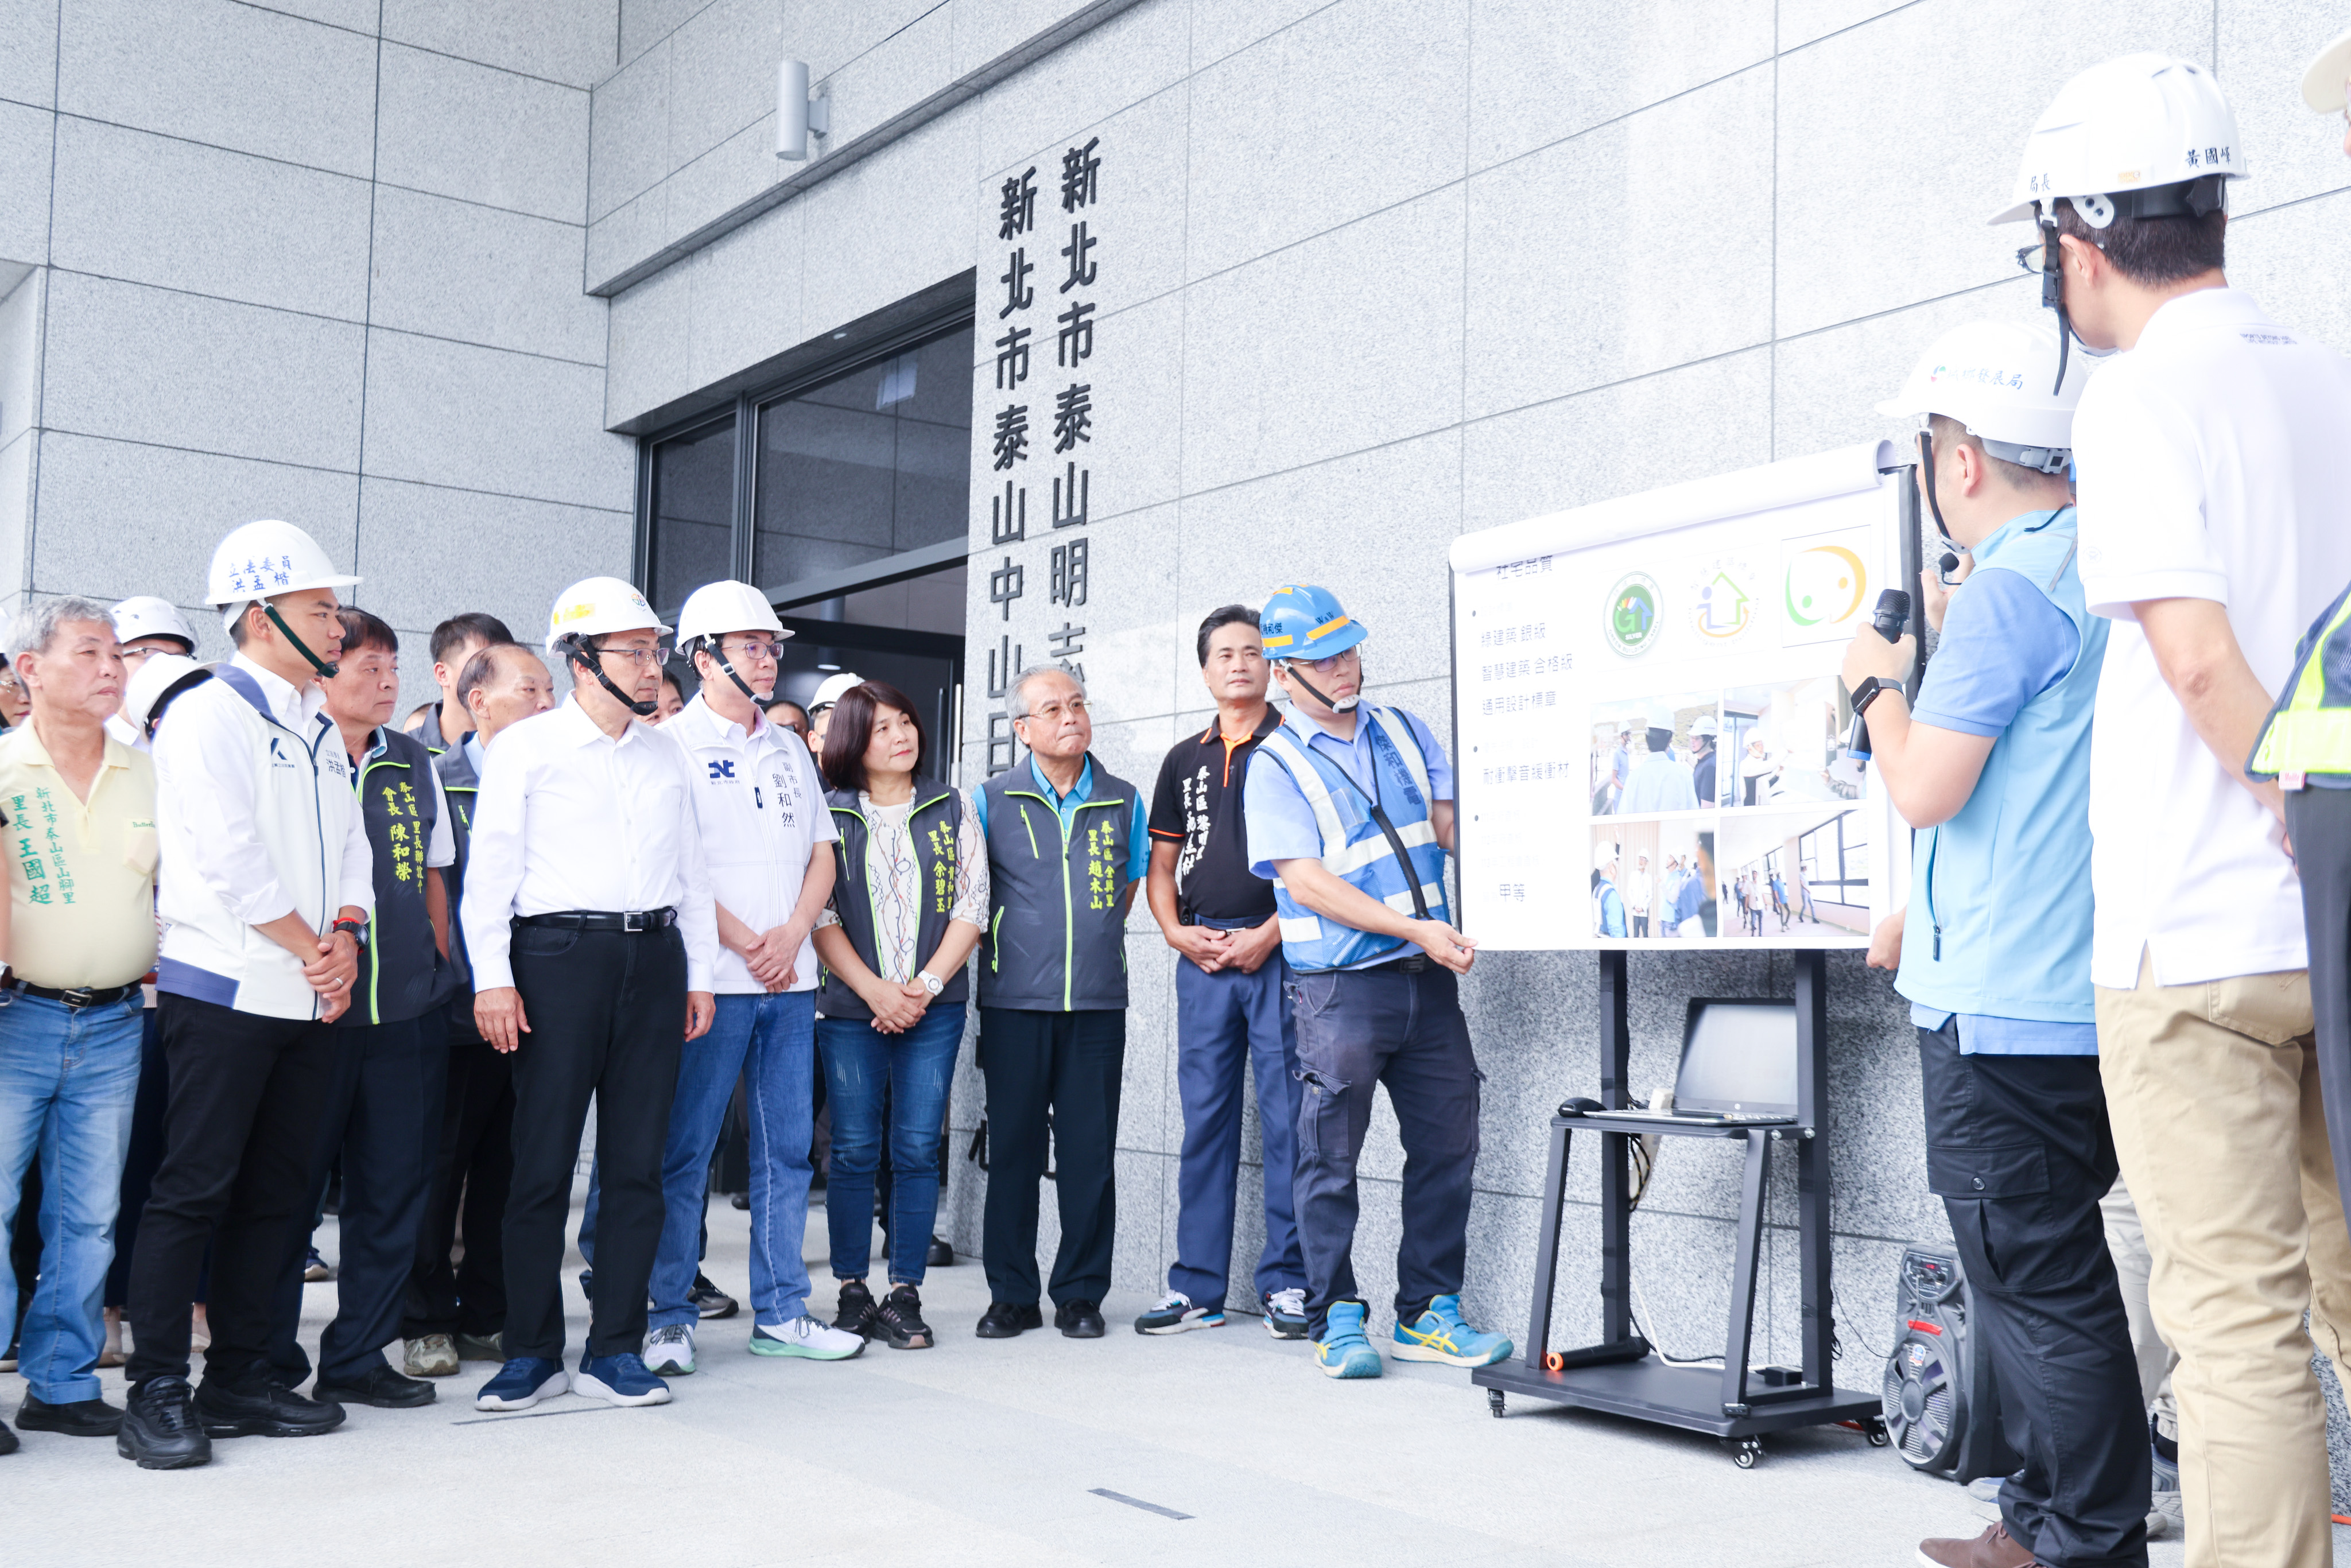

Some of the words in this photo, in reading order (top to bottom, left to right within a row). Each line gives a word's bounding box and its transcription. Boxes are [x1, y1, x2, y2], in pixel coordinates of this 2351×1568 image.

[2185, 146, 2230, 168] 黃國峰
[2030, 173, 2051, 193] 局長
[229, 556, 292, 577] 立法委員
[232, 572, 289, 593] 洪孟楷
[1481, 627, 1516, 648] 綠建築
[1520, 622, 1546, 642] 銀級
[1625, 632, 1642, 640] SILVER
[1481, 659, 1530, 682] 智慧建築
[1534, 653, 1573, 674] 合格級
[1482, 690, 1557, 716] 通用設計標章
[782, 762, 802, 799] 副市長
[1483, 760, 1569, 785] 耐衝擊音緩衝材
[11, 795, 34, 830] 里長
[382, 787, 403, 816] 會長
[772, 773, 795, 828] 劉和然
[36, 787, 76, 904] 新北市泰山區山腳里
[390, 822, 412, 882] 陳和榮
[928, 830, 945, 856] 里長
[1088, 829, 1101, 856] 里長
[19, 838, 53, 905] 王國超
[1088, 860, 1104, 910] 趙木山
[933, 861, 947, 913] 余碧玉
[1499, 884, 1525, 902] 甲等
